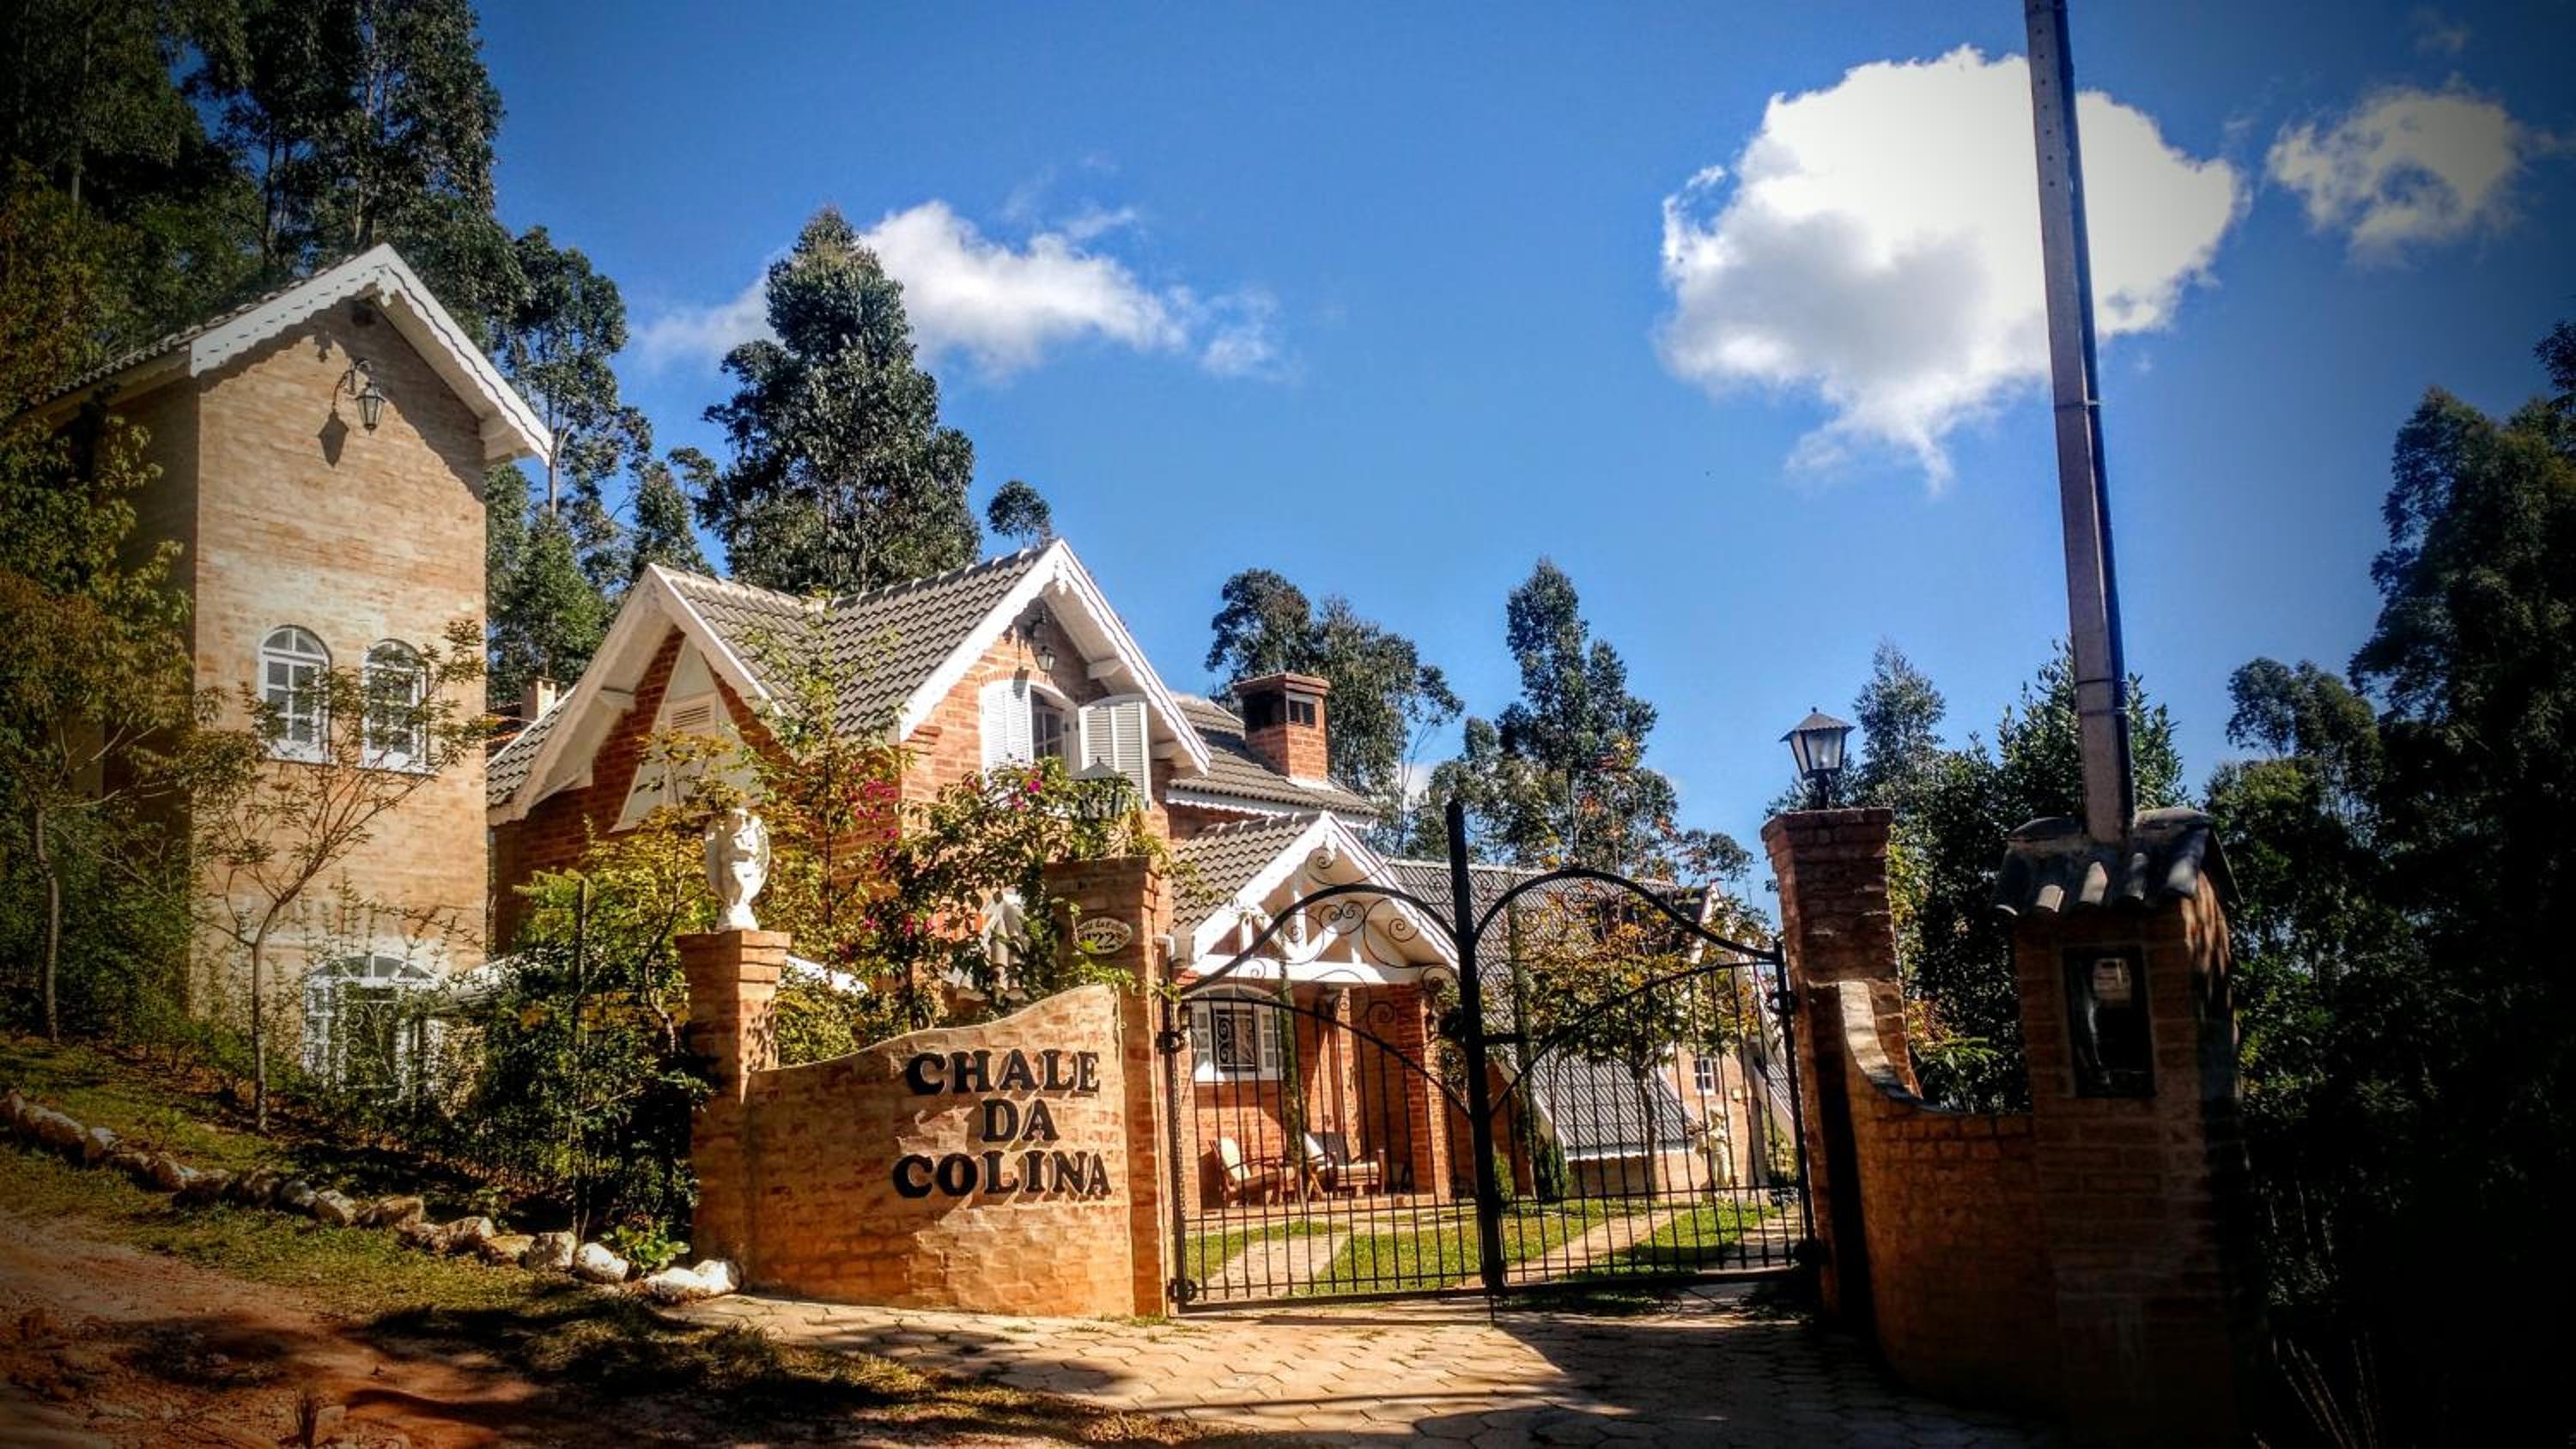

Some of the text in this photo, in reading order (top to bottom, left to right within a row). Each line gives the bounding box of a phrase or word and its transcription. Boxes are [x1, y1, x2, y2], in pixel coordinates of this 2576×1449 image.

[905, 1048, 1101, 1095] CHALE
[981, 1098, 1060, 1143] DA
[892, 1149, 1113, 1200] COLINA
